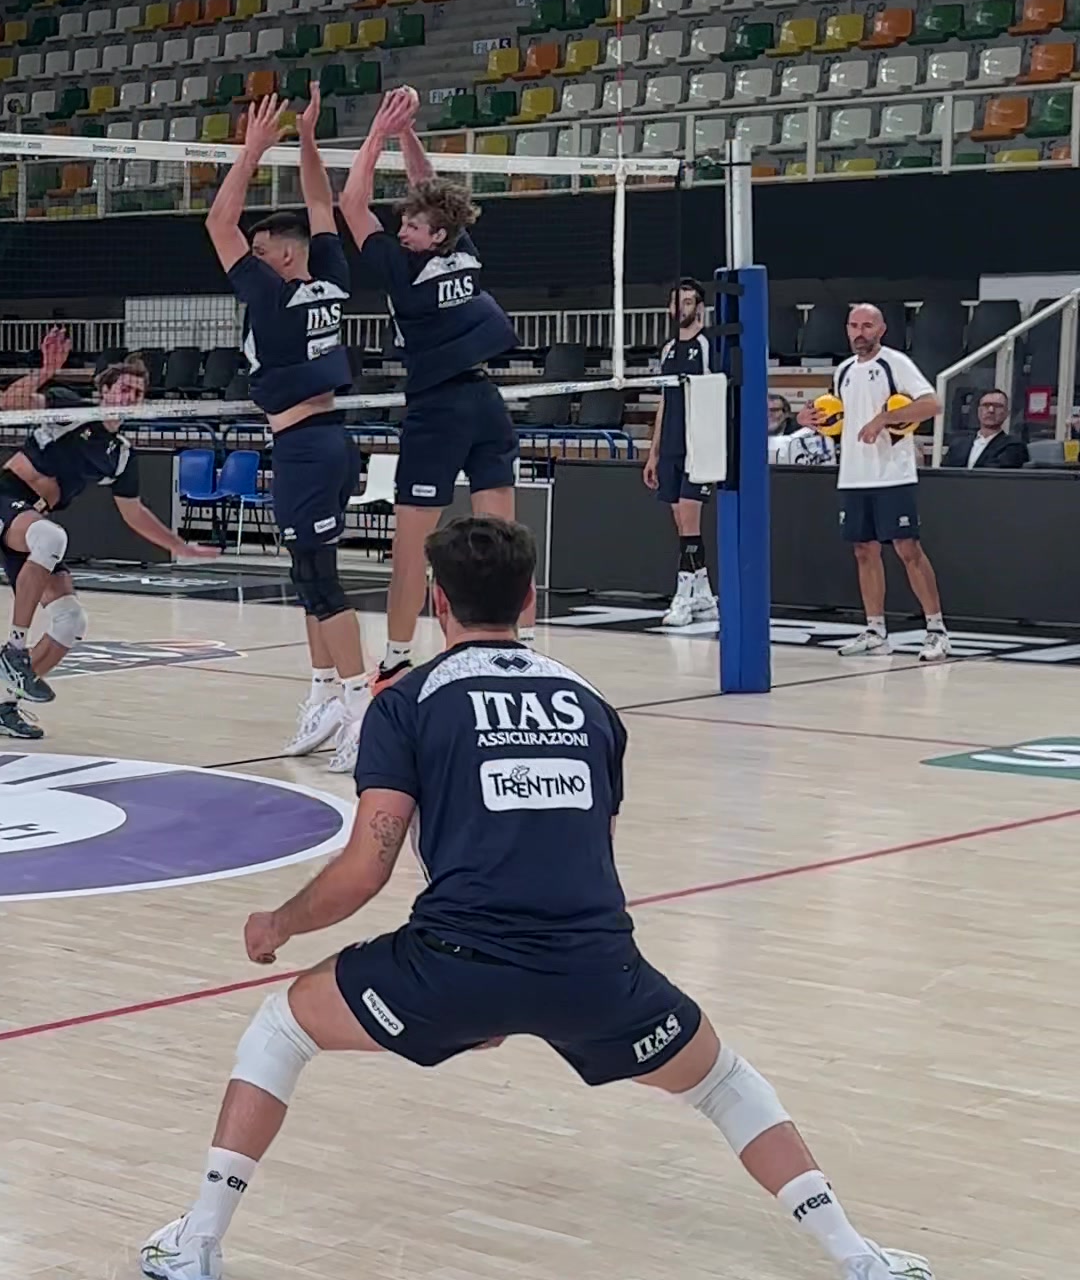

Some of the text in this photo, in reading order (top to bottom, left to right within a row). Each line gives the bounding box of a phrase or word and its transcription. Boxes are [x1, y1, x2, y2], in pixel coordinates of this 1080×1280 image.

[467, 690, 585, 731] ITAS
[477, 731, 589, 747] ASSICURAZIONI
[632, 1014, 679, 1060] ITAS
